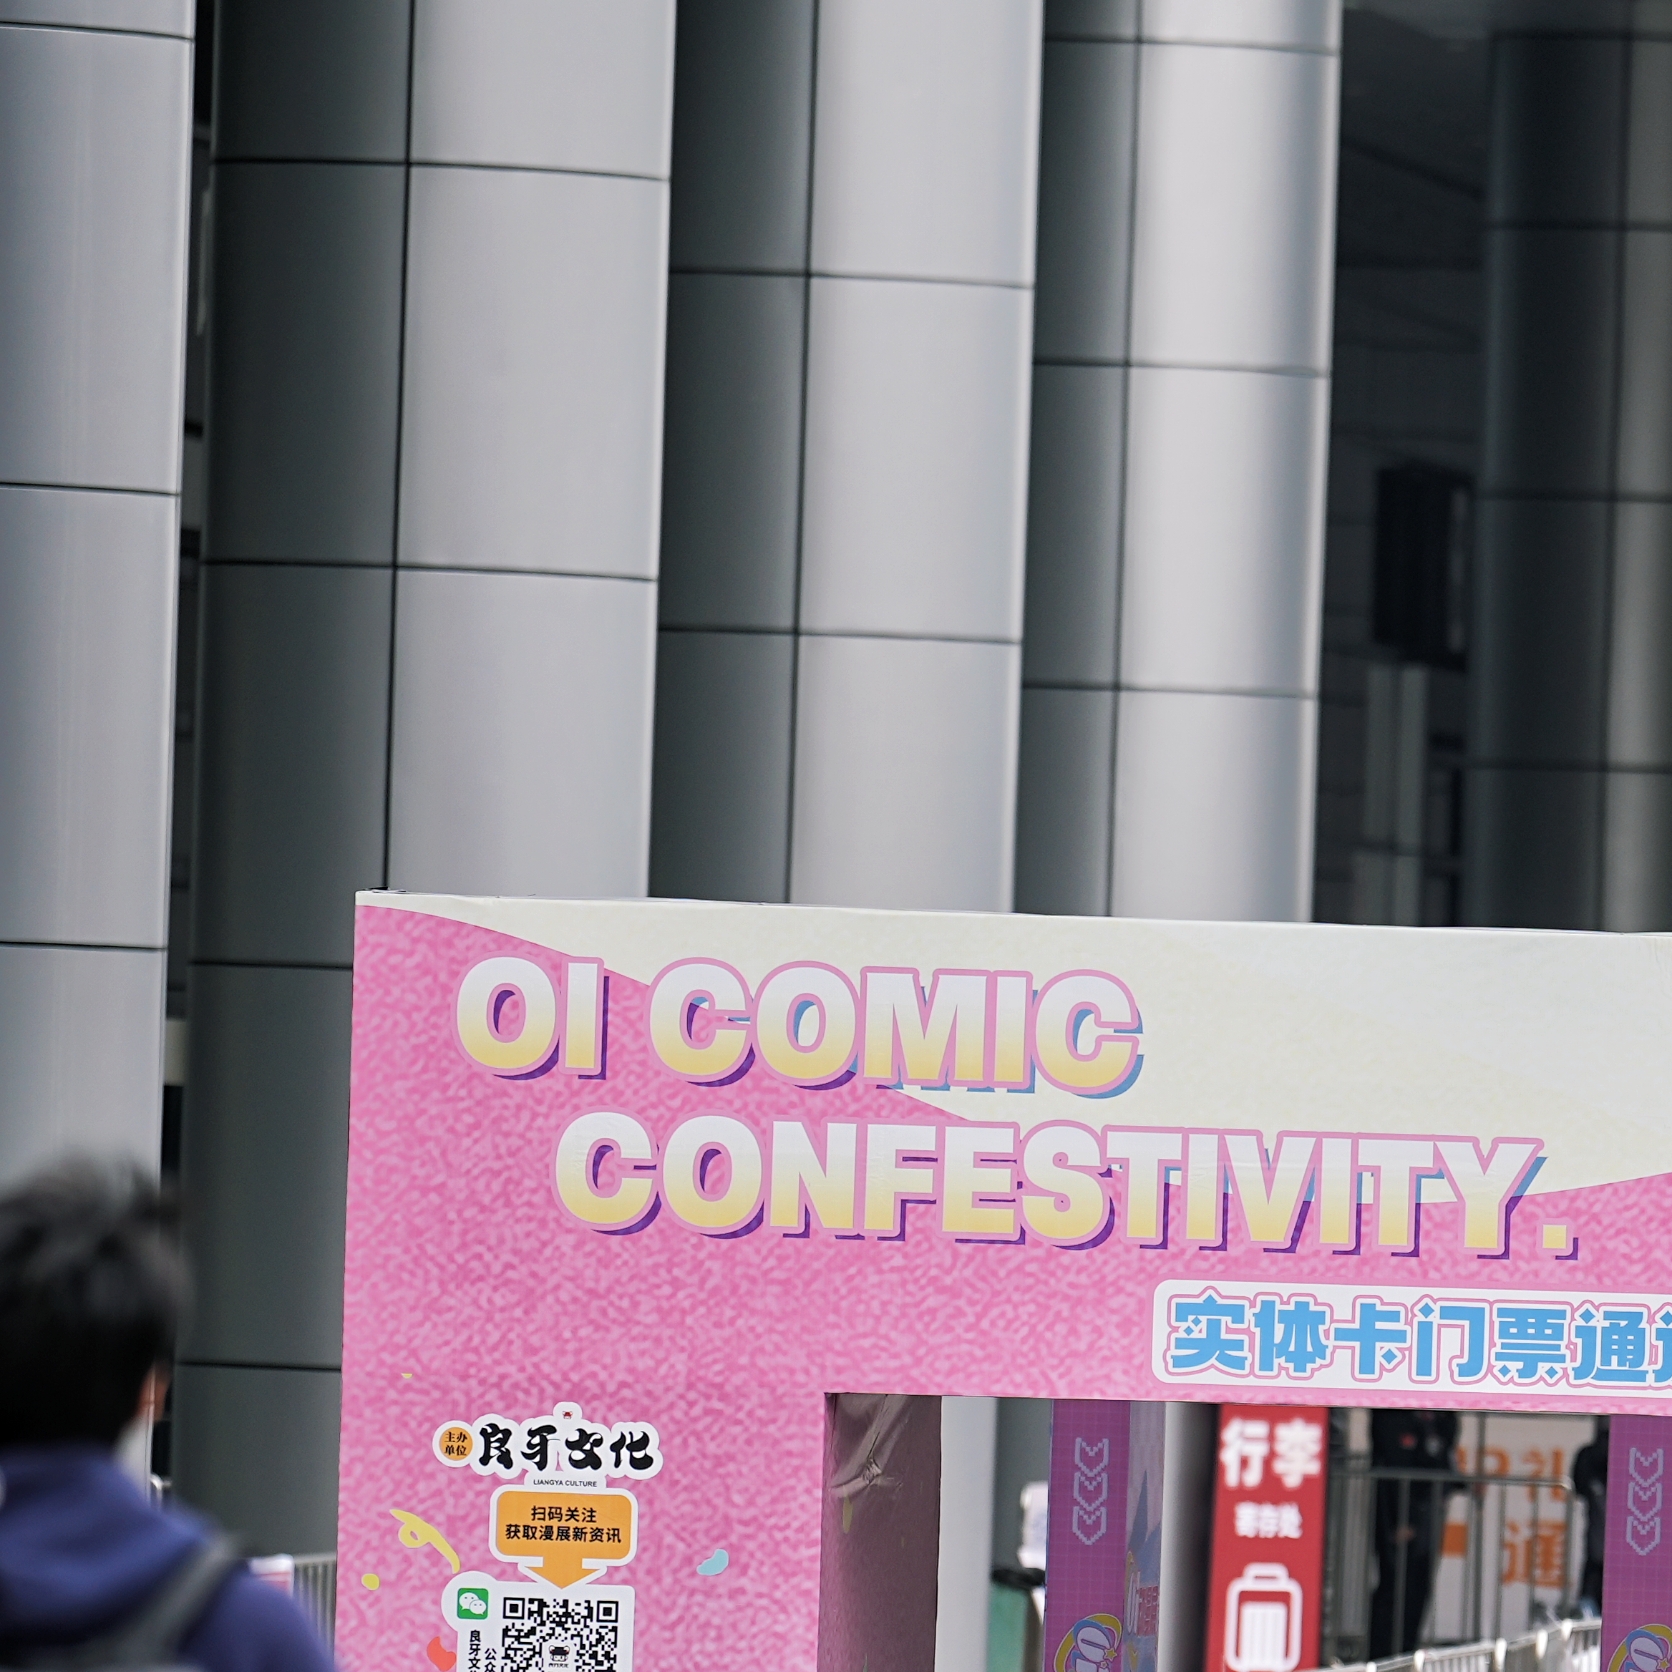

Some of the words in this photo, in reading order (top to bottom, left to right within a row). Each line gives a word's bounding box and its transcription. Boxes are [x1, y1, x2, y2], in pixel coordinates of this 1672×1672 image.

[456, 956, 608, 1079] OI
[648, 956, 1143, 1099] COMIC
[554, 1110, 1577, 1259] CONFESTIVITY.
[444, 1431, 468, 1443] 主办
[445, 1446, 468, 1457] 单位
[478, 1422, 654, 1472] 良牙文化
[1221, 1418, 1321, 1489] 行李
[532, 1479, 564, 1487] LIANGYA
[531, 1505, 597, 1523] 扫码关注
[505, 1524, 622, 1543] 获取漫展新资讯
